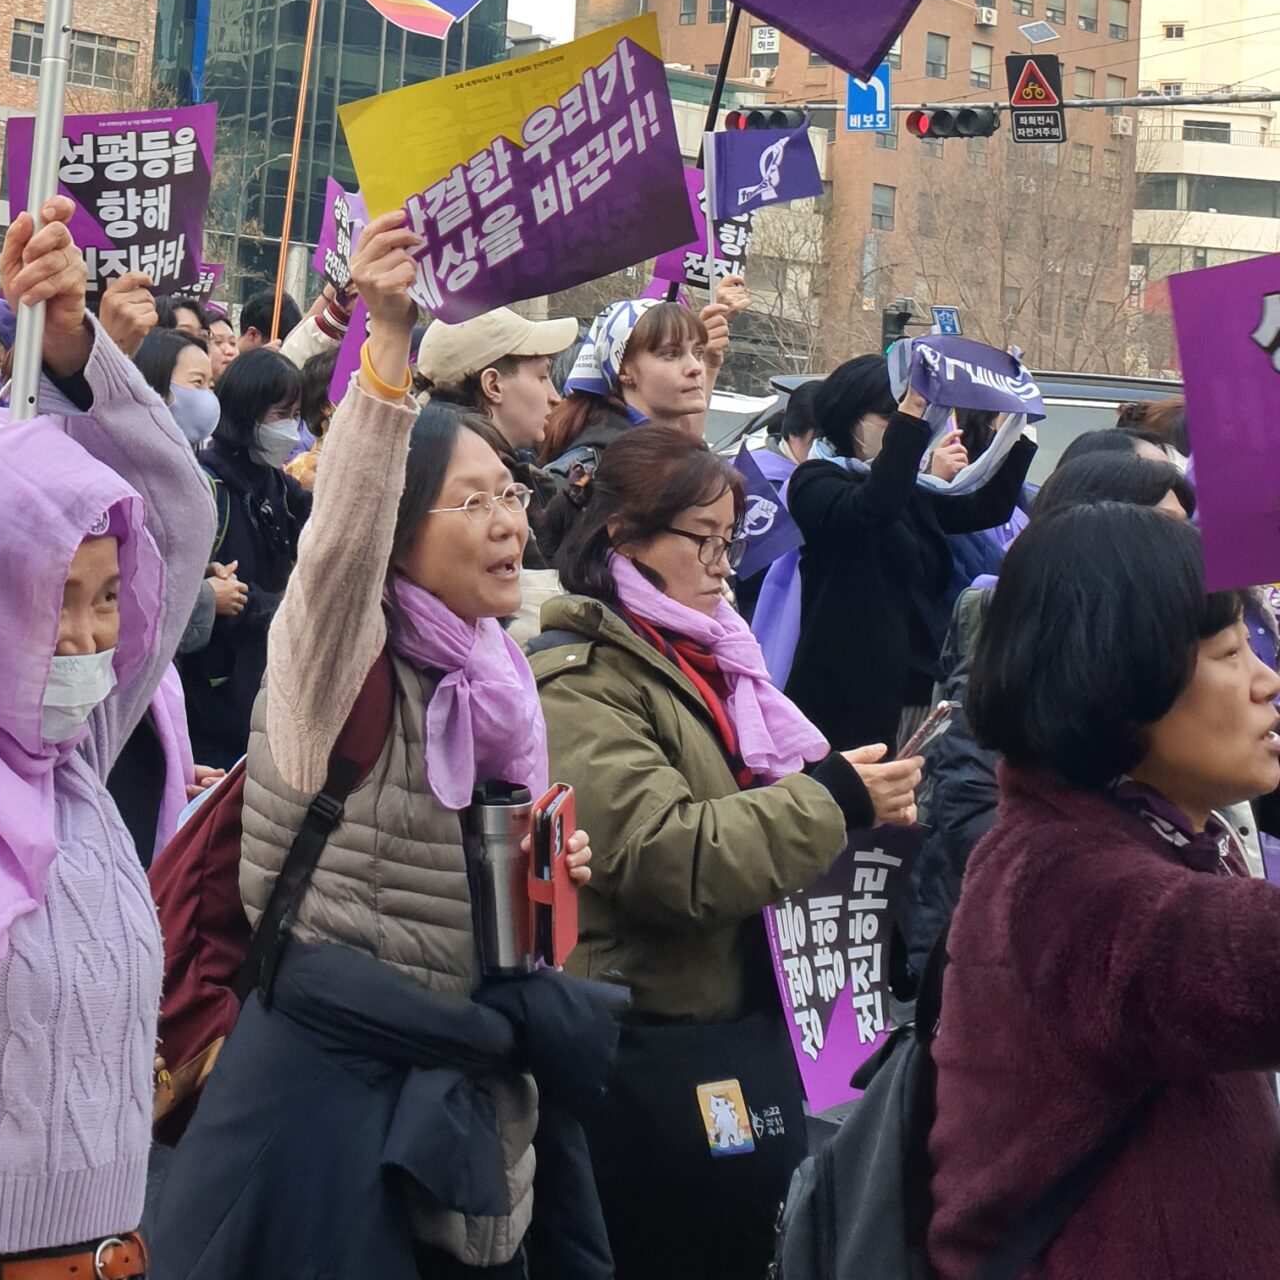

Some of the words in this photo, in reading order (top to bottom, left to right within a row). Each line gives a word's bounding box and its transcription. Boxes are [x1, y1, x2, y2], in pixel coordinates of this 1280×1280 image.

[59, 126, 197, 184] 성평등을
[522, 38, 636, 165] 우리가
[849, 113, 887, 128] 비보호
[1017, 127, 1059, 137] 자전거주의
[96, 183, 171, 239] 향해
[531, 90, 661, 225] 바꾼다!
[776, 890, 824, 1061] 성평등
[808, 894, 845, 1003] 향해
[848, 847, 903, 1044] 전진하라
